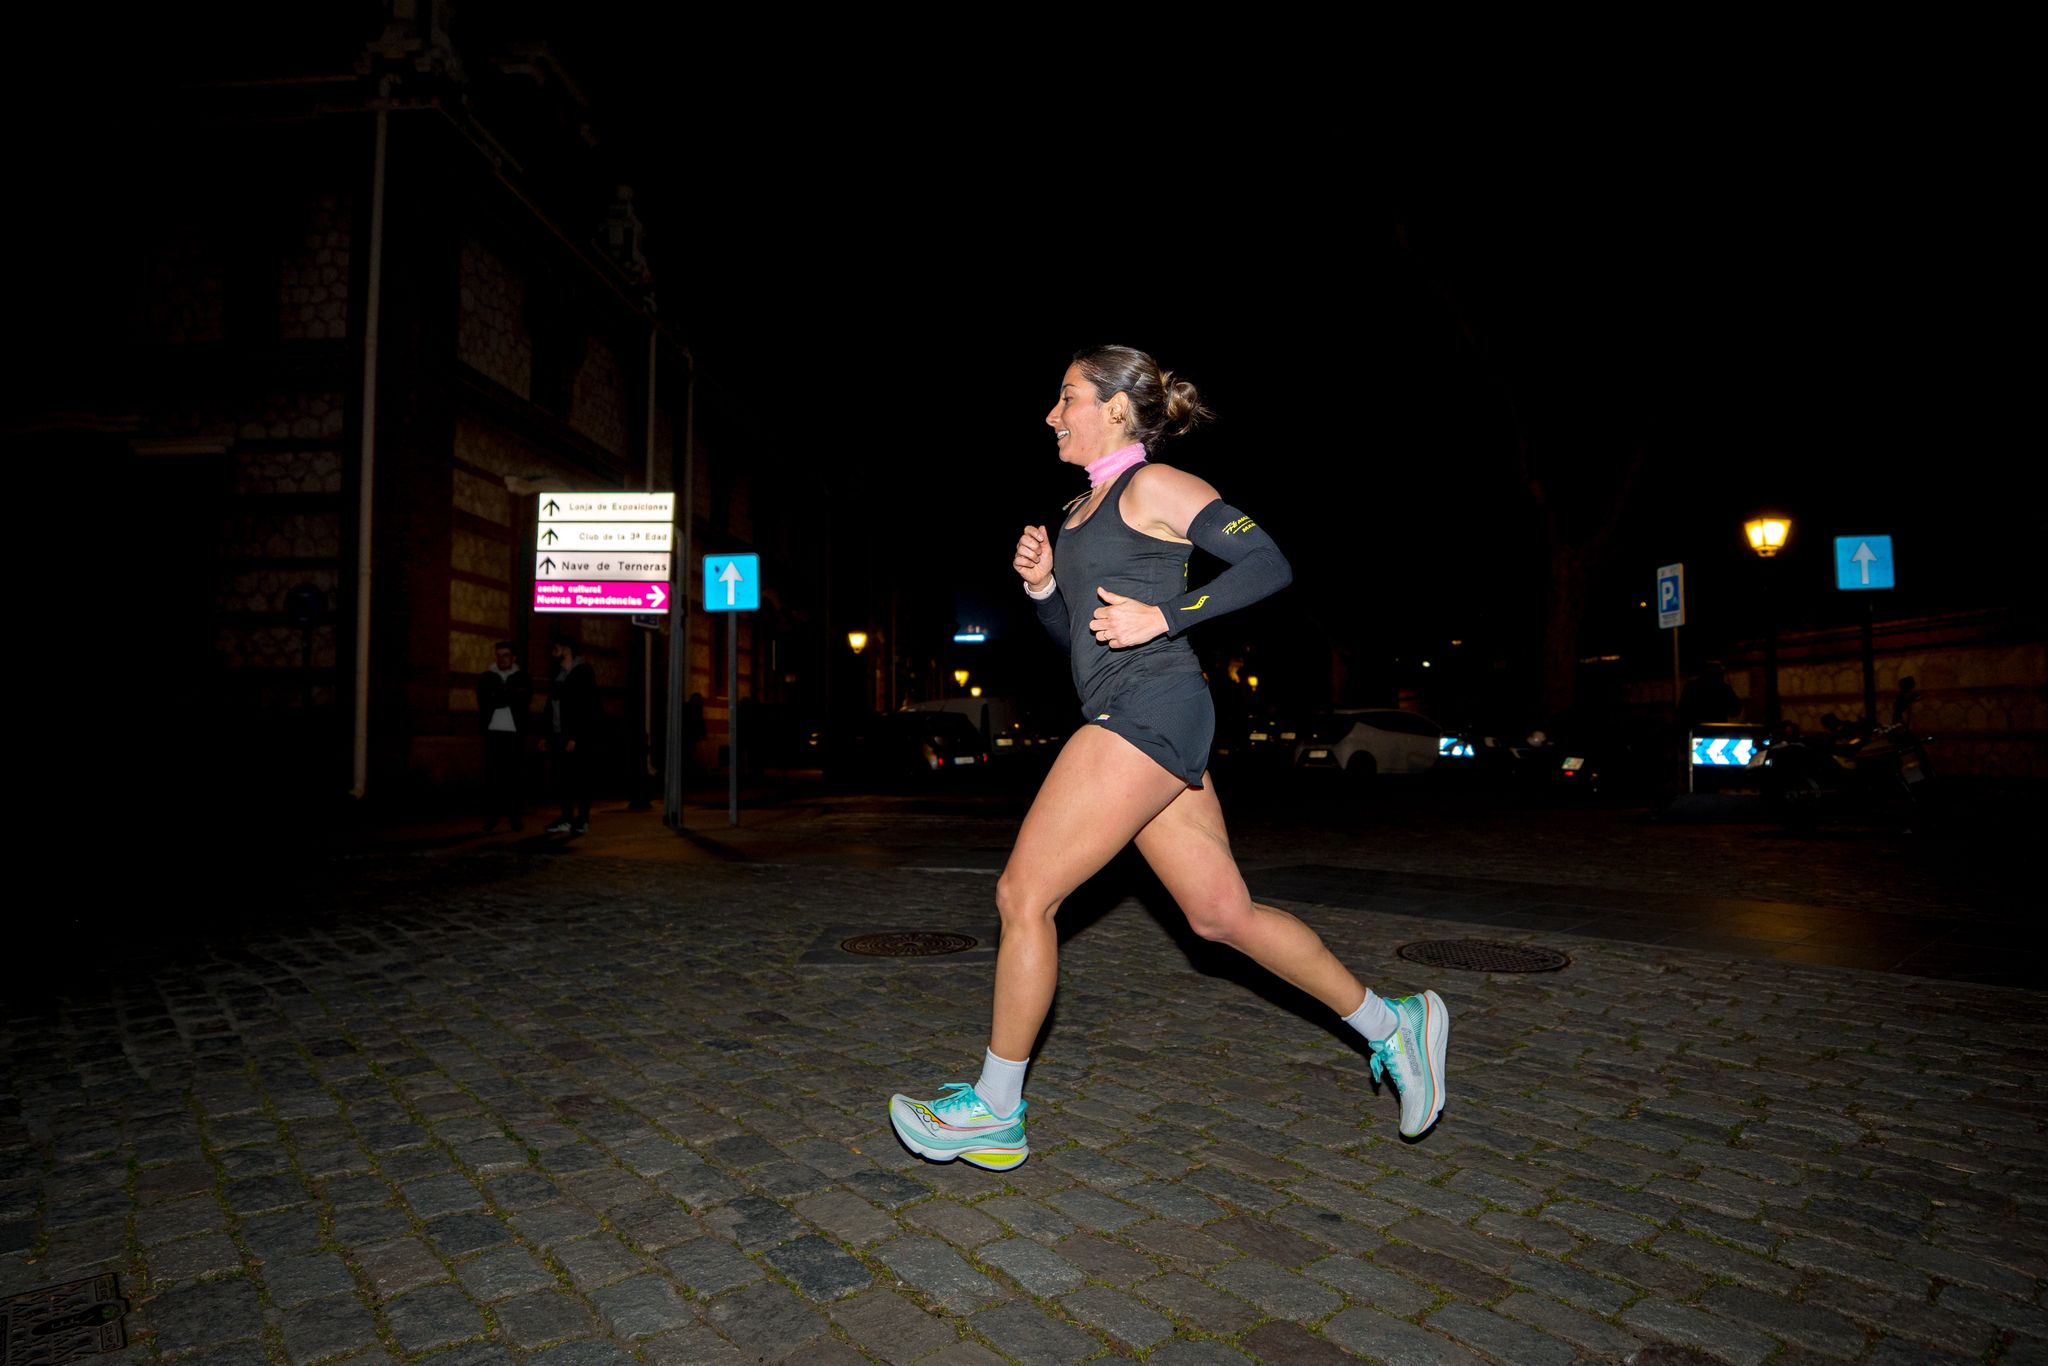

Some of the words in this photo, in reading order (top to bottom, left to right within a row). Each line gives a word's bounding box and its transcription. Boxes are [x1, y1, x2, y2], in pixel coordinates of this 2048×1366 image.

[569, 502, 592, 512] Lonja
[597, 502, 606, 510] de
[612, 502, 668, 511] Exposiciones
[579, 532, 598, 540] Club
[603, 532, 612, 540] de
[617, 532, 625, 540] la
[630, 532, 640, 540] 3ª
[645, 532, 667, 540] Edad
[562, 561, 589, 571] Nave
[597, 561, 610, 571] de
[618, 561, 667, 571] Terneras
[537, 584, 564, 593] centro
[568, 584, 602, 594] cultural
[537, 595, 571, 604] Nuevas
[576, 595, 642, 606] Dependencias
